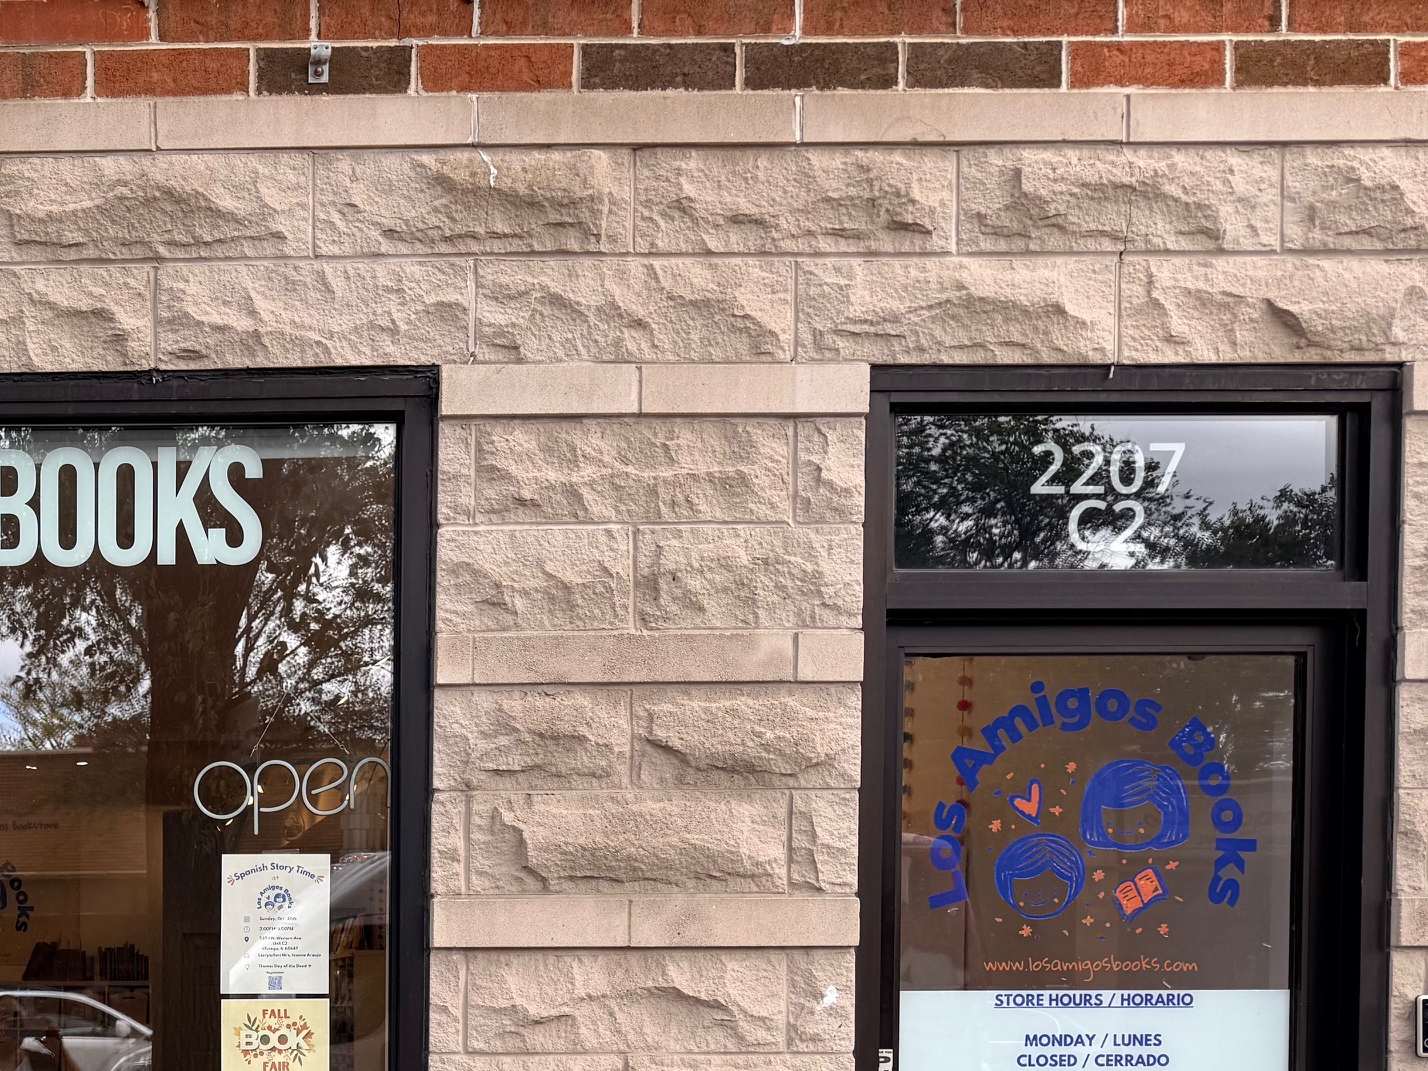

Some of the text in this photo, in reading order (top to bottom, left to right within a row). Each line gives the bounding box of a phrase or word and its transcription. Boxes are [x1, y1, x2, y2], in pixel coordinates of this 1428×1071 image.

[1029, 442, 1186, 495] 2207
[1068, 500, 1146, 552] C2
[193, 757, 392, 835] open
[928, 680, 1257, 911] Los Amigos Books
[12, 821, 59, 832] Bookstore
[234, 862, 316, 880] Spanish Story Time
[260, 885, 283, 897] Amigos
[984, 955, 1199, 982] www.losamigosbooks.com
[993, 992, 1194, 1008] STORE HOURS / HORARIO
[262, 1008, 290, 1019] FALL
[240, 1030, 312, 1050] BOOK
[1024, 1033, 1163, 1049] MONDAY / LUNES
[262, 1061, 290, 1071] FAIR
[1016, 1053, 1170, 1069] CLOSED / CERRADO
